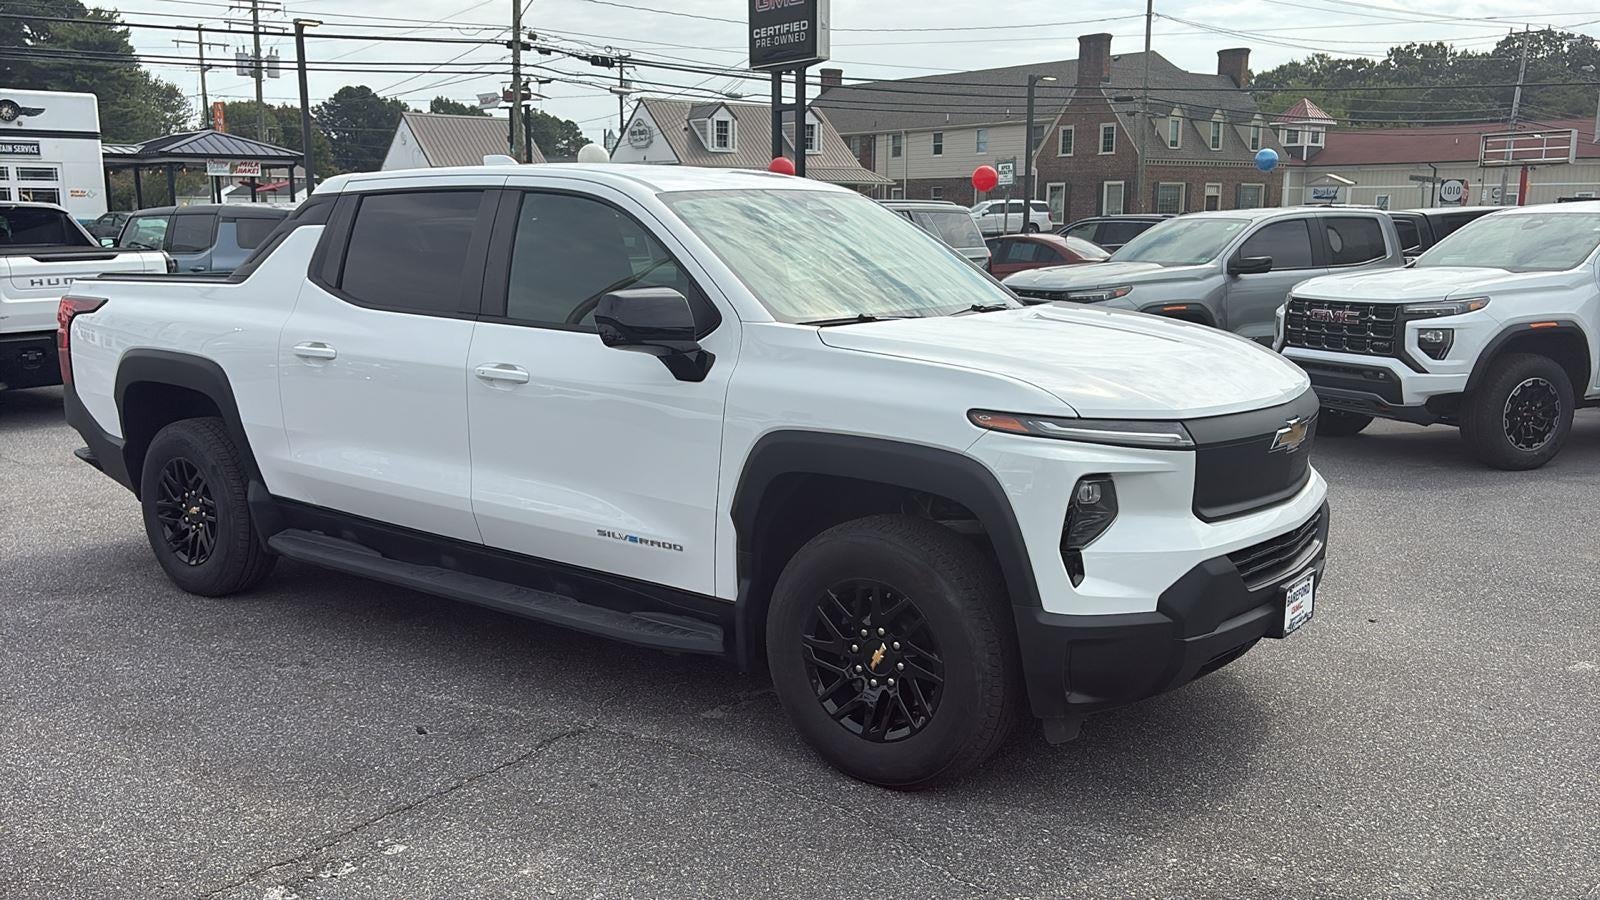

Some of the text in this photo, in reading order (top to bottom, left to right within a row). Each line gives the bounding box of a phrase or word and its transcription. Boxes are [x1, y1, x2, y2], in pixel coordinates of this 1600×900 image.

[753, 20, 809, 39] CERTIFIED
[755, 32, 806, 48] PRE-OWNED
[13, 144, 39, 153] SERVICE
[1443, 186, 1460, 195] 1010
[1311, 309, 1360, 325] GMC
[596, 528, 684, 552] SILVERADO
[1286, 582, 1311, 607] BAREFORD
[1291, 600, 1304, 615] GMC
